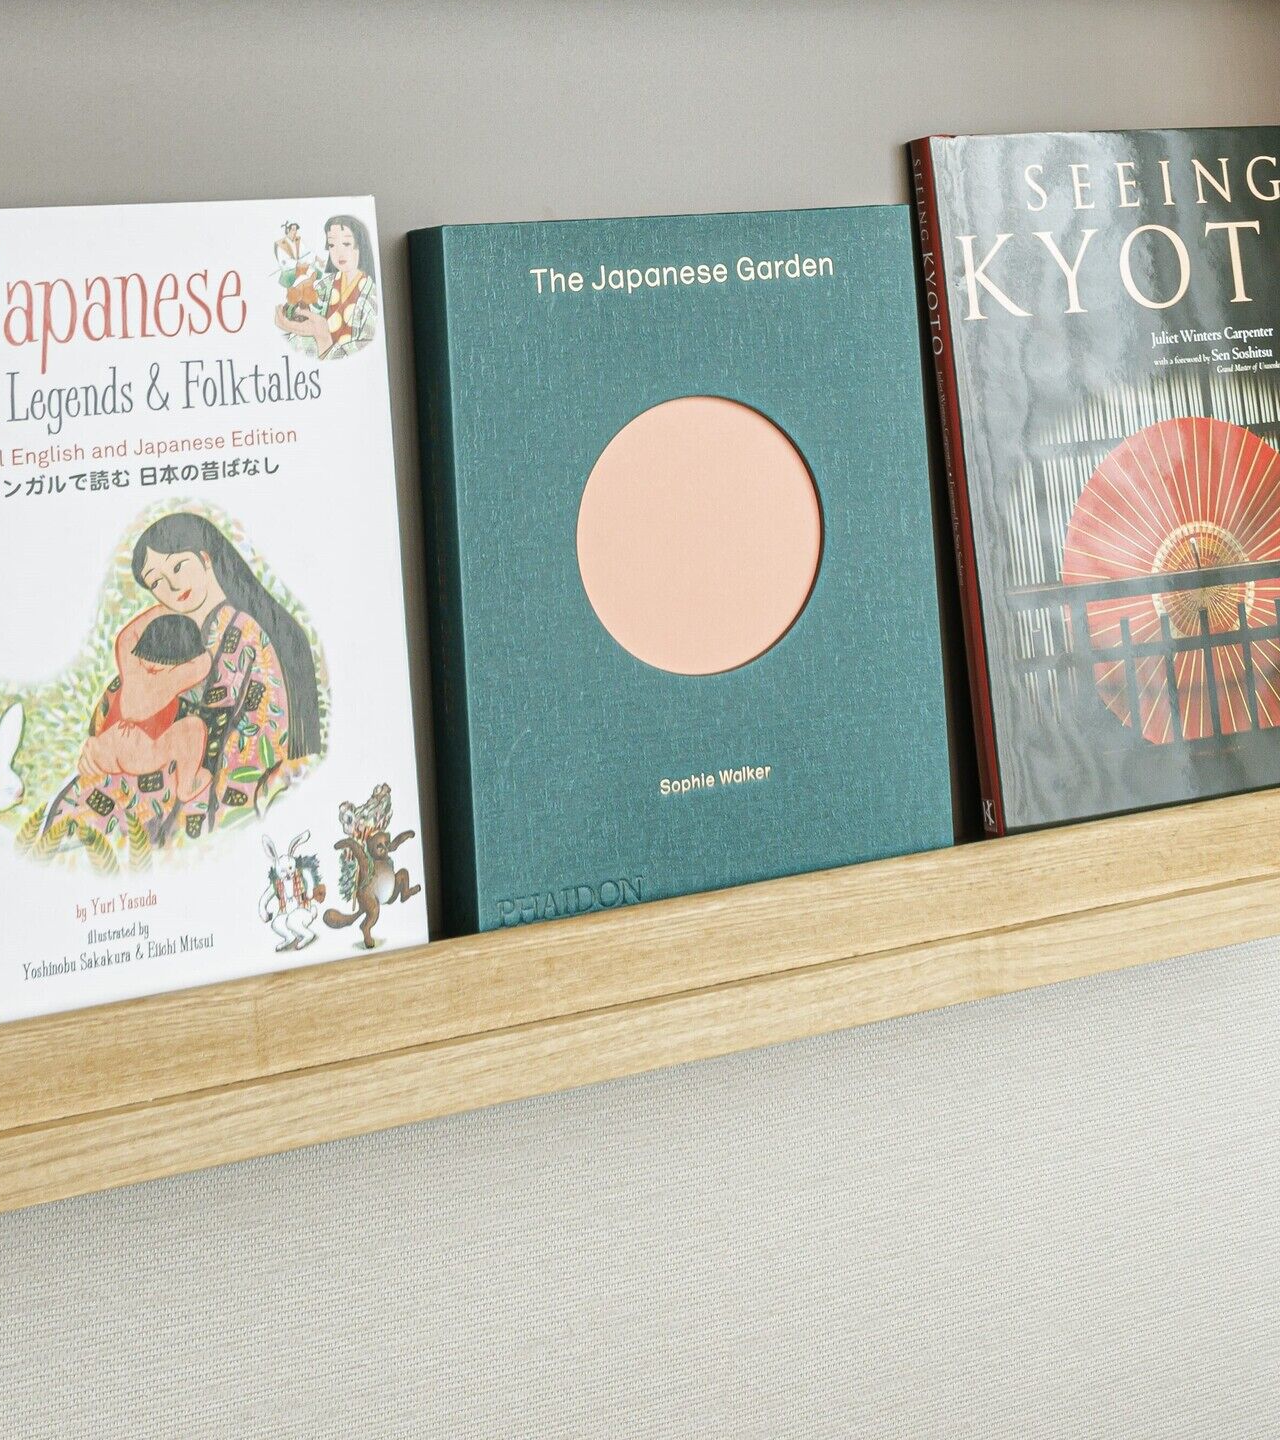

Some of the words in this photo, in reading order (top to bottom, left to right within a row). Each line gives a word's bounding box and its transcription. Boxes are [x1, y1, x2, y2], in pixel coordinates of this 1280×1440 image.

[530, 267, 584, 294] The
[591, 263, 729, 295] Japanese
[736, 253, 835, 282] Garden
[913, 158, 930, 242] SEEING
[922, 252, 944, 356] KYOTO
[1151, 330, 1179, 349] Juliet
[1180, 329, 1222, 343] Winters
[1224, 326, 1274, 343] Carpenter
[1202, 353, 1211, 364] by
[1211, 348, 1231, 362] Sen
[1231, 345, 1273, 360] Soshitsu
[5, 366, 134, 435] Legends
[146, 361, 170, 411] &
[180, 356, 321, 410] Folktales
[11, 442, 85, 468] English
[91, 439, 128, 459] and
[133, 435, 226, 458] Japanese
[231, 428, 298, 448] Edition
[140, 456, 281, 487] 日本の昔ばなし
[660, 772, 716, 796] Sophie
[718, 765, 771, 785] Walker
[76, 904, 87, 922] by
[91, 897, 115, 916] Yuri
[120, 889, 158, 911] Yasuda
[496, 875, 645, 927] PHAIDON
[87, 923, 136, 945] illustrated
[138, 921, 150, 939] by
[22, 957, 77, 981] Yoshinobu
[79, 948, 131, 971] Sakakura
[135, 943, 145, 960] &
[148, 938, 177, 959] Eiichi
[179, 933, 215, 953] Mitsui
